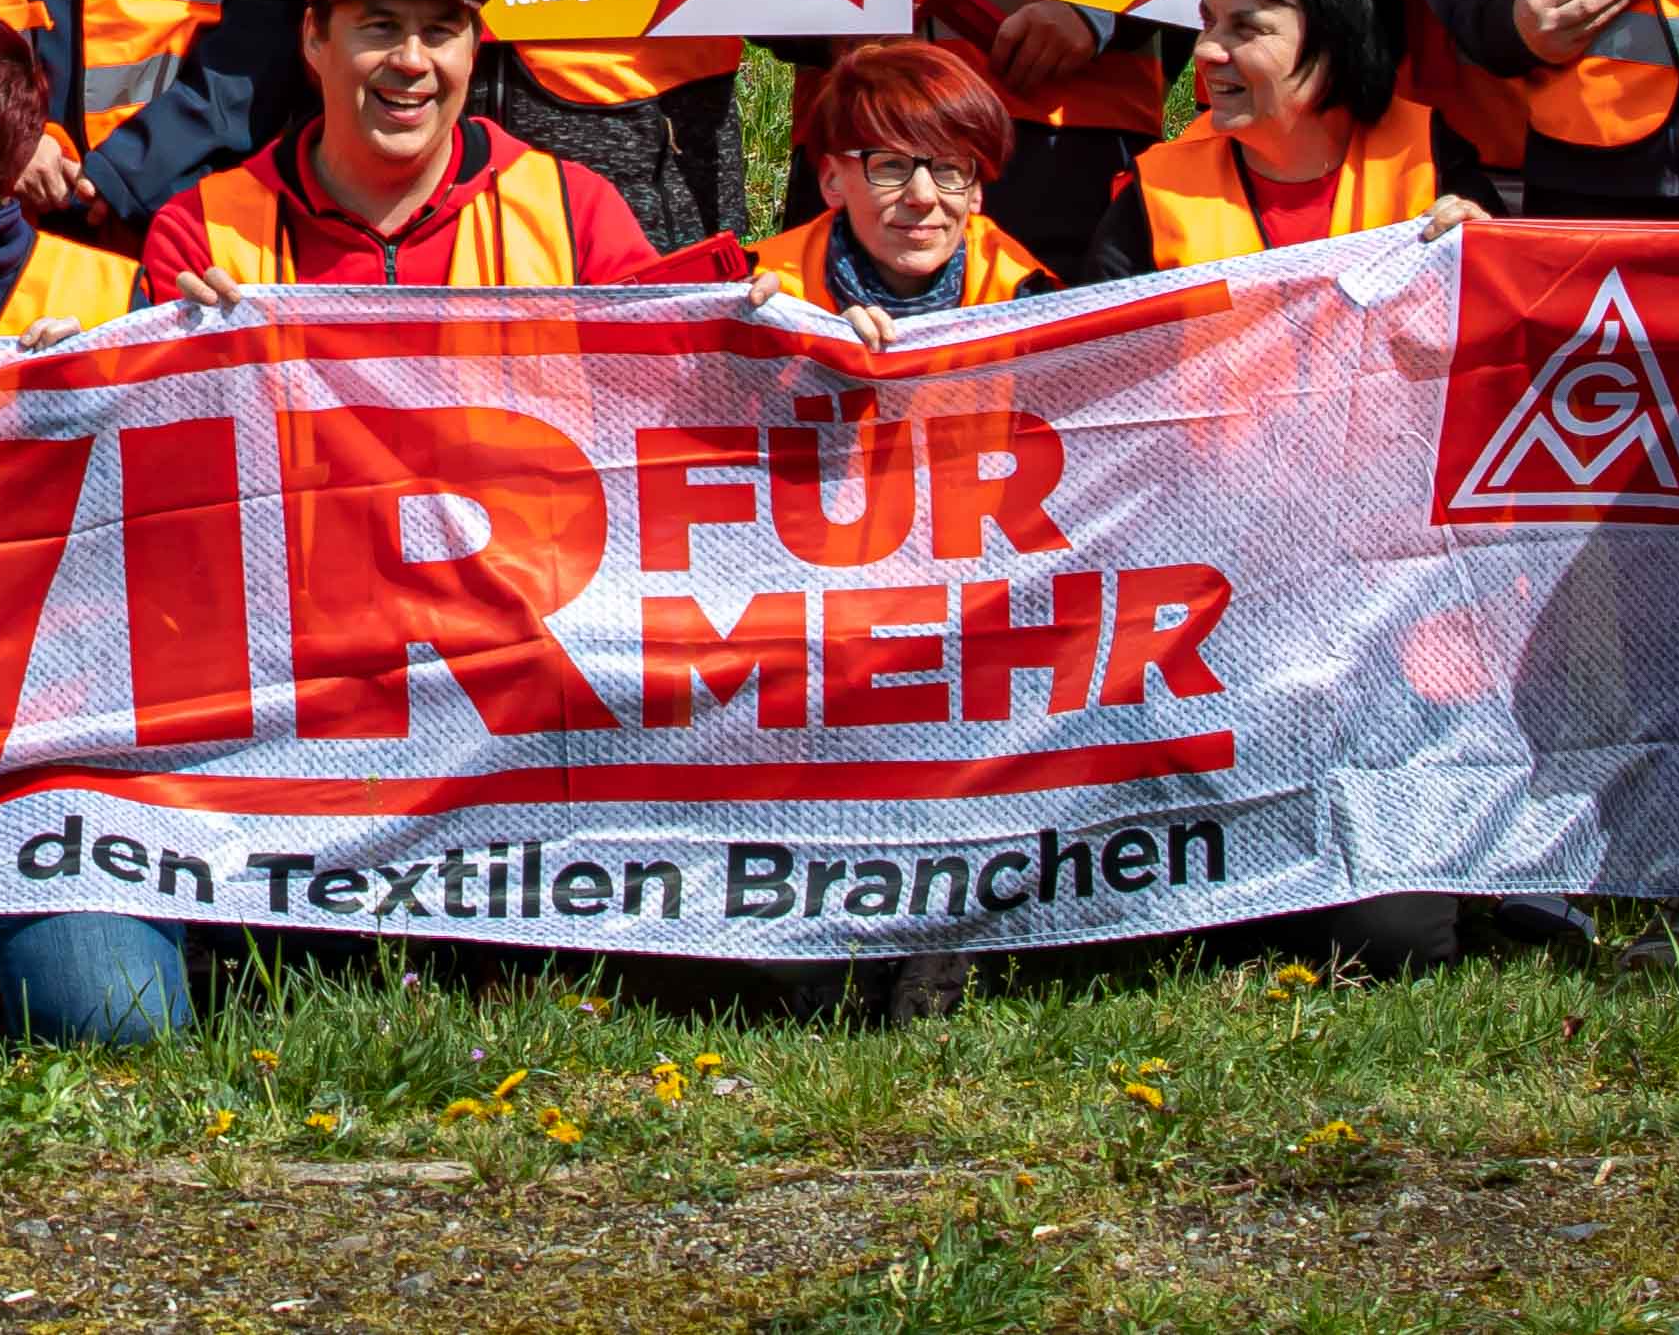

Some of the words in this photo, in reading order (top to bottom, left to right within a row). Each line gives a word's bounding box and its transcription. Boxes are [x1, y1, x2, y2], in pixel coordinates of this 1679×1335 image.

[635, 386, 1071, 572] FÜR
[641, 563, 1234, 731] MEHR
[17, 816, 214, 903] den
[247, 841, 681, 919] Textilen
[724, 819, 1227, 919] Branchen
